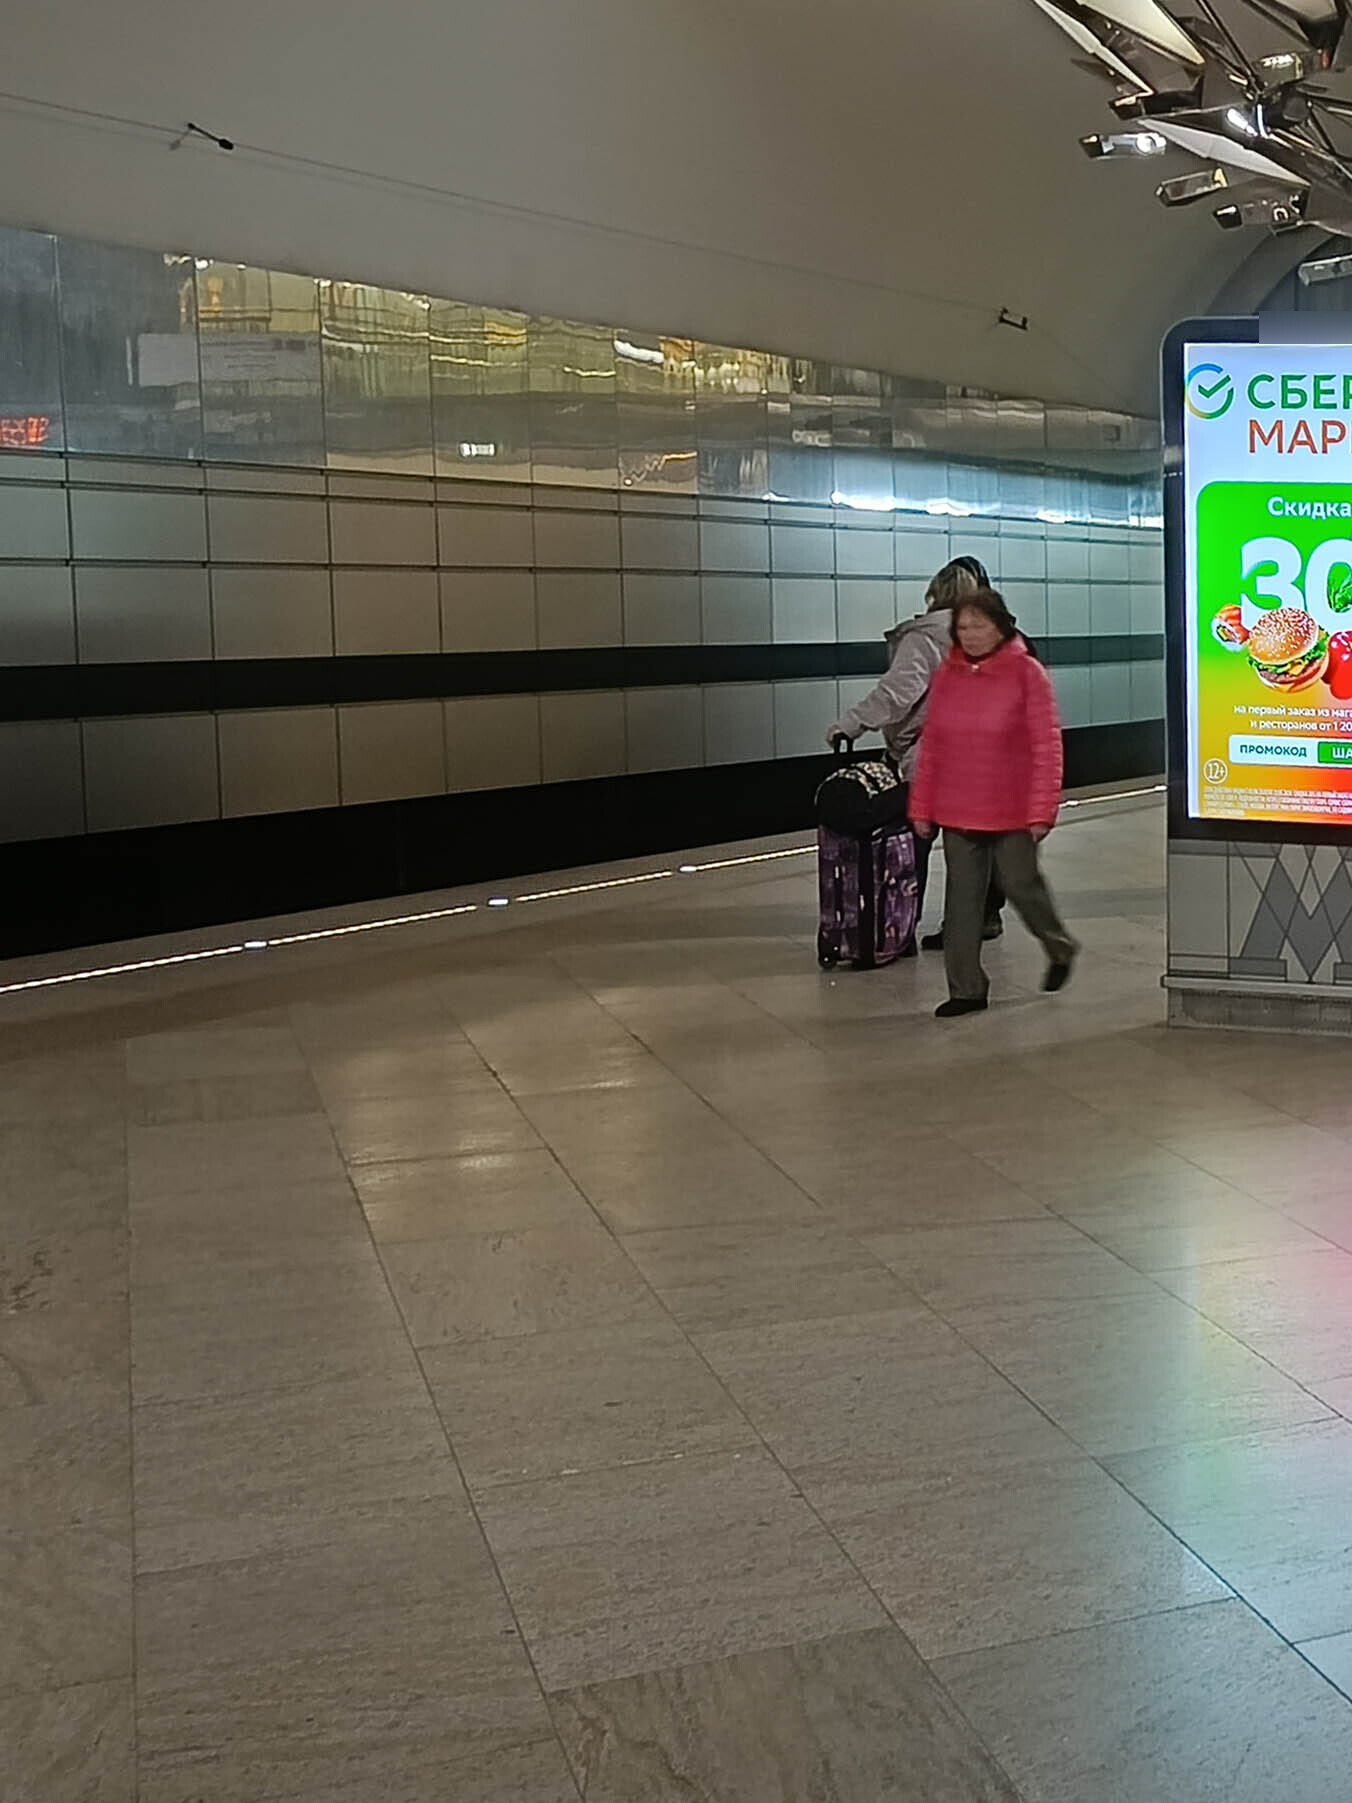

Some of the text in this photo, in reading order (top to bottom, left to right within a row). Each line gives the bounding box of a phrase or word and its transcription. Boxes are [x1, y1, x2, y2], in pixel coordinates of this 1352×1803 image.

[1267, 496, 1352, 519] Скидка
[1234, 705, 1247, 714] на
[1248, 704, 1285, 717] первый
[1287, 707, 1316, 717] заказ
[1317, 708, 1329, 718] из
[1259, 720, 1318, 732] ресторанов
[1239, 744, 1308, 758] ПРОМОКОД
